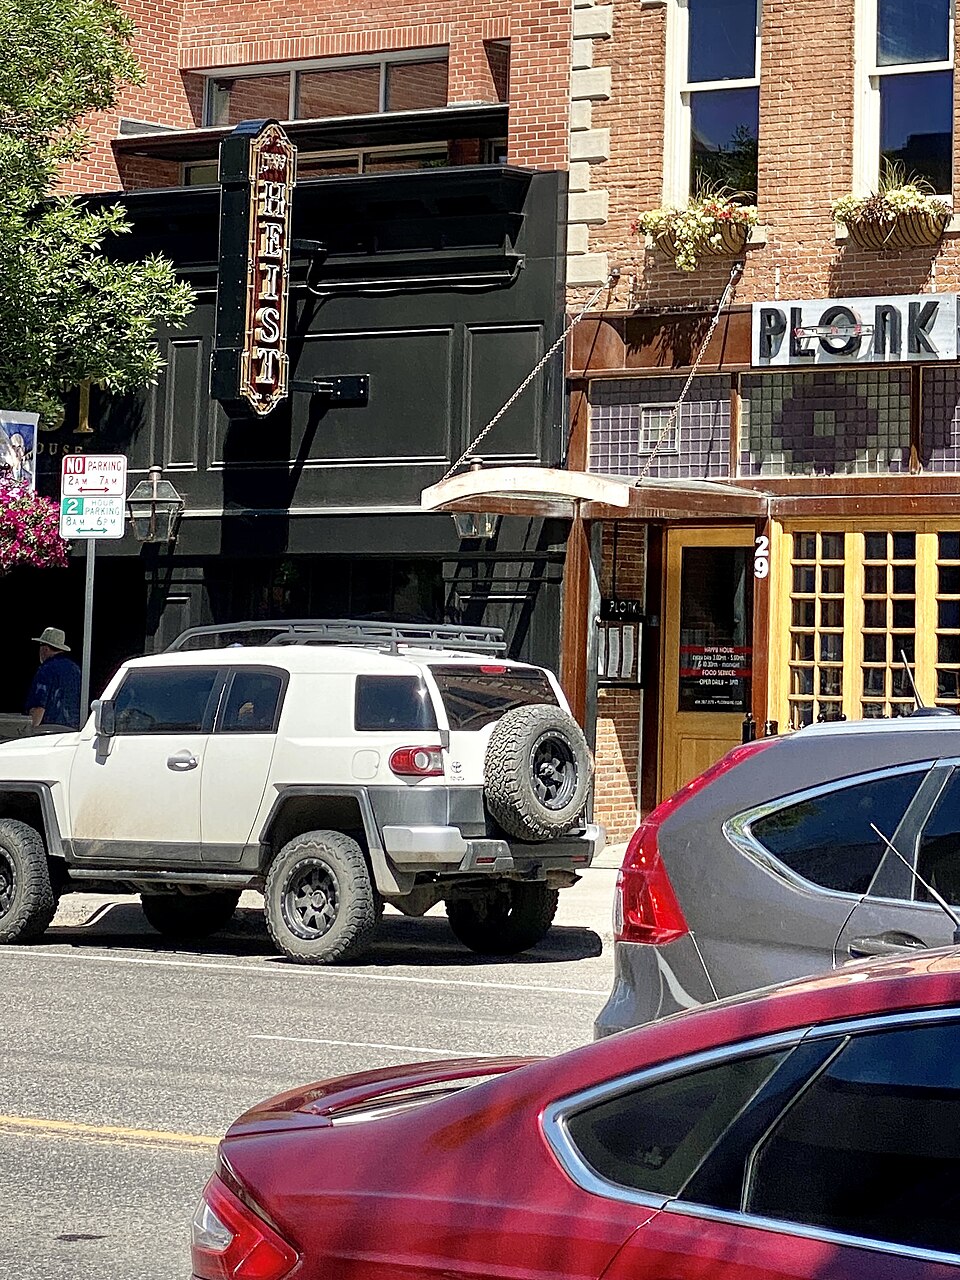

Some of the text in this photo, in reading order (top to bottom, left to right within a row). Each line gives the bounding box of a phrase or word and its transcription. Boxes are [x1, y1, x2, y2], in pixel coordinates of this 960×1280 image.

[254, 180, 286, 384] HEIST
[759, 301, 939, 357] PLONK
[36, 441, 83, 455] OUSE
[66, 457, 121, 474] NO PARKING
[67, 498, 79, 514] 2
[85, 507, 120, 516] PARKING
[609, 600, 638, 613] PLONK
